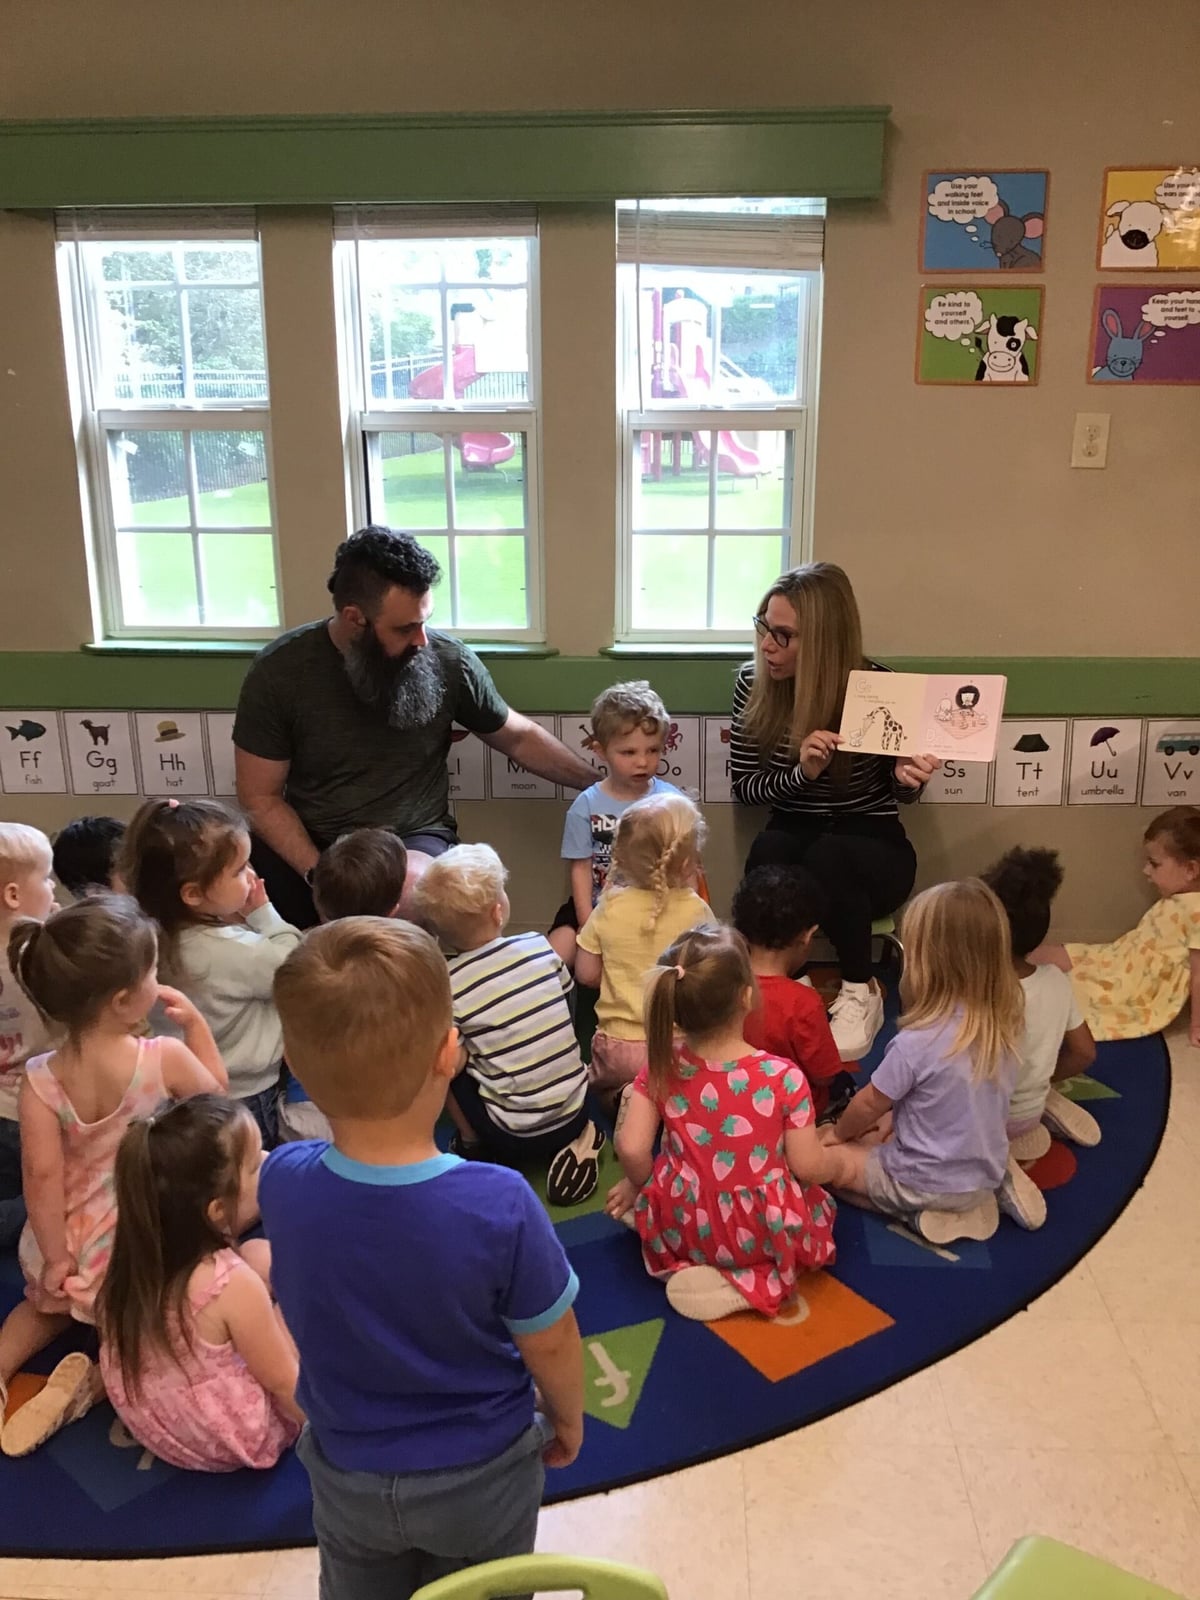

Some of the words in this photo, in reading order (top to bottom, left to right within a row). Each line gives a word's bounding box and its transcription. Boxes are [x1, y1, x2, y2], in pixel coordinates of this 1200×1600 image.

[20, 750, 42, 768] Ff
[86, 750, 118, 776] Gg
[160, 753, 186, 770] Hh
[507, 757, 528, 774] M
[943, 760, 966, 778] Ss
[1016, 762, 1043, 780] Tt
[1091, 760, 1118, 778] Uu
[1164, 762, 1194, 780] Vv
[24, 774, 43, 784] fish
[92, 777, 116, 792] goat
[165, 776, 184, 786] hat
[1017, 786, 1040, 797] tent
[1081, 784, 1124, 795] umbrella
